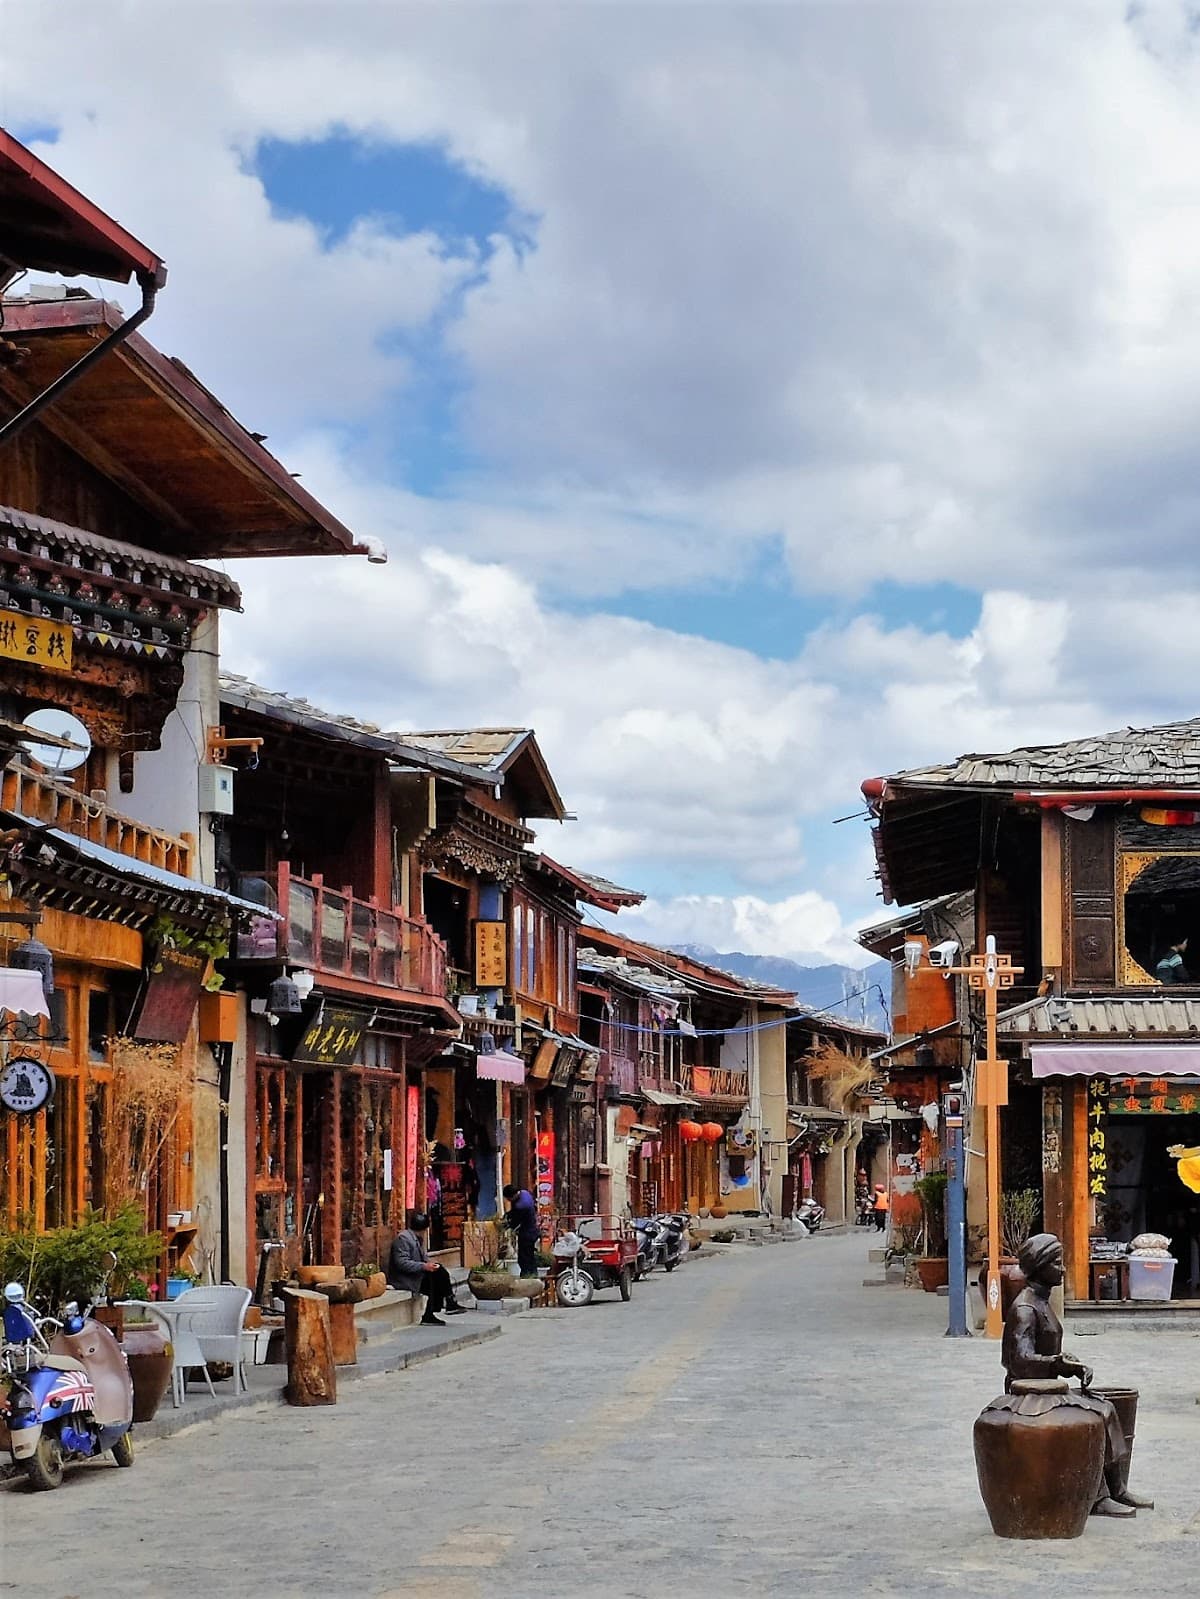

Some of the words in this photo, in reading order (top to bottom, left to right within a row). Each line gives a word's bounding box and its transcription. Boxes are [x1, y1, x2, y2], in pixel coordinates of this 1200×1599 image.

[1089, 1079, 1109, 1196] 牦牛肉批发
